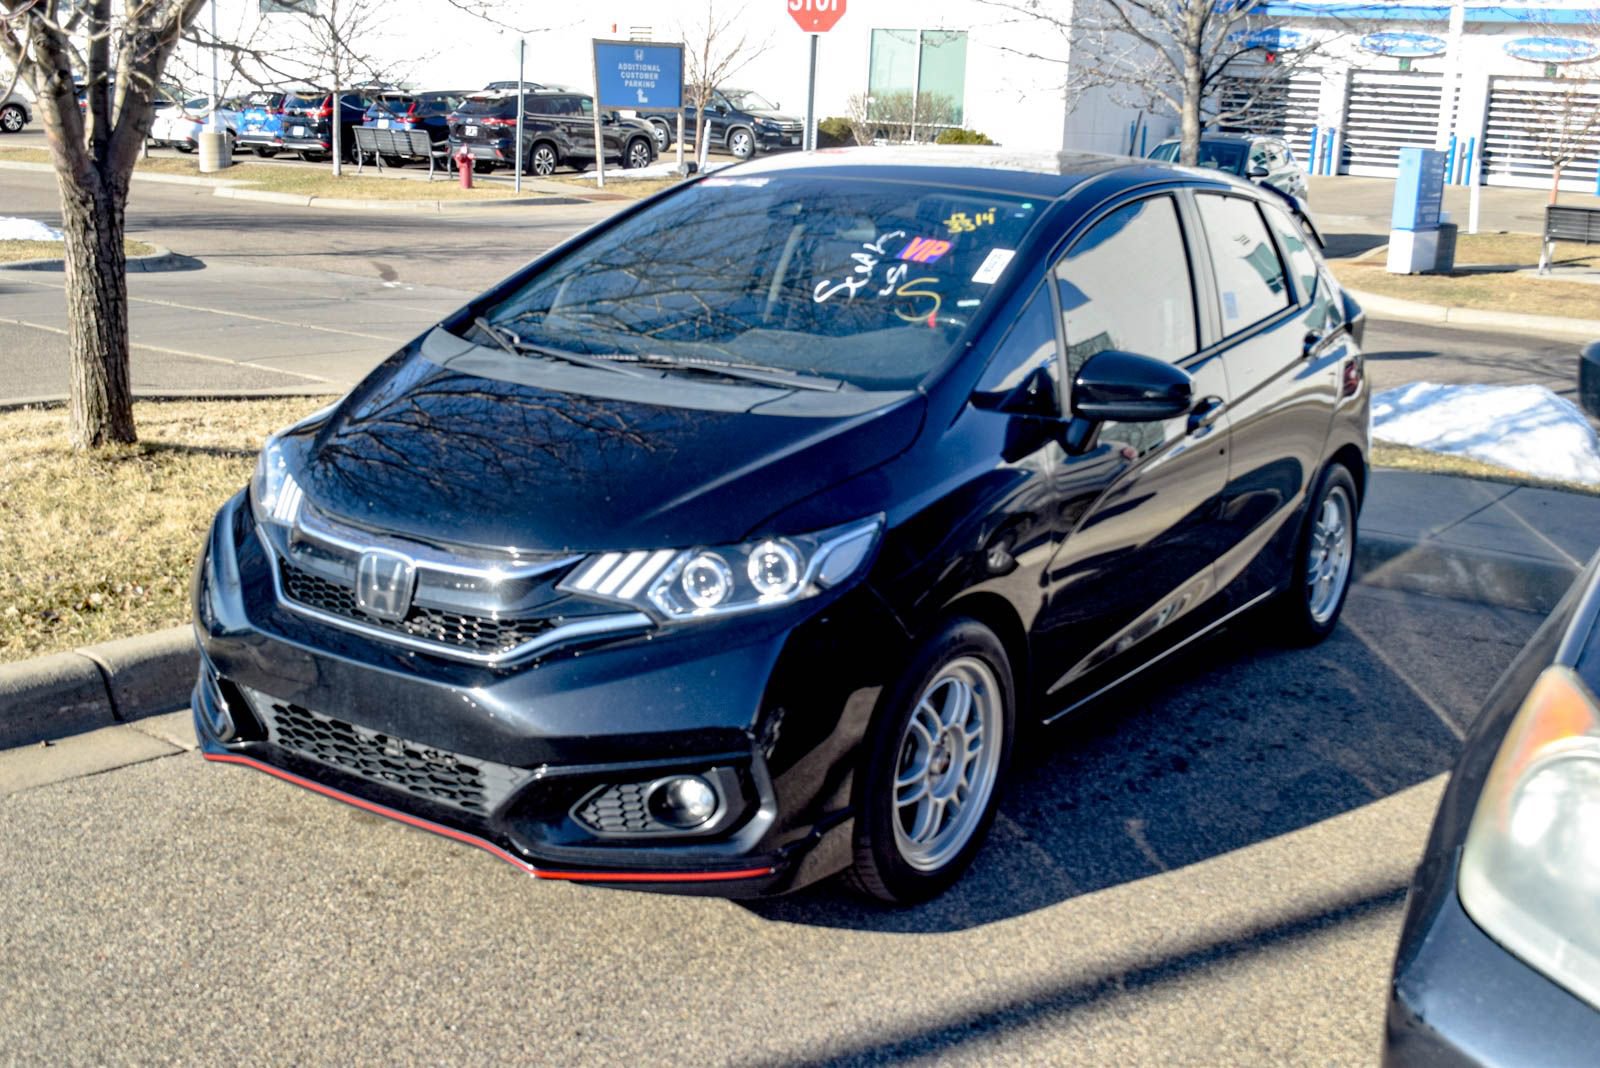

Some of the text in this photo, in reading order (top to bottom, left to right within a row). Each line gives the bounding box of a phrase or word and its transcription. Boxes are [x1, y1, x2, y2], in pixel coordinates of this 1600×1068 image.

[618, 62, 661, 73] ADDITIONAL
[620, 71, 659, 80] CUSTOMER
[624, 79, 656, 88] PARKING
[900, 236, 952, 262] VIP
